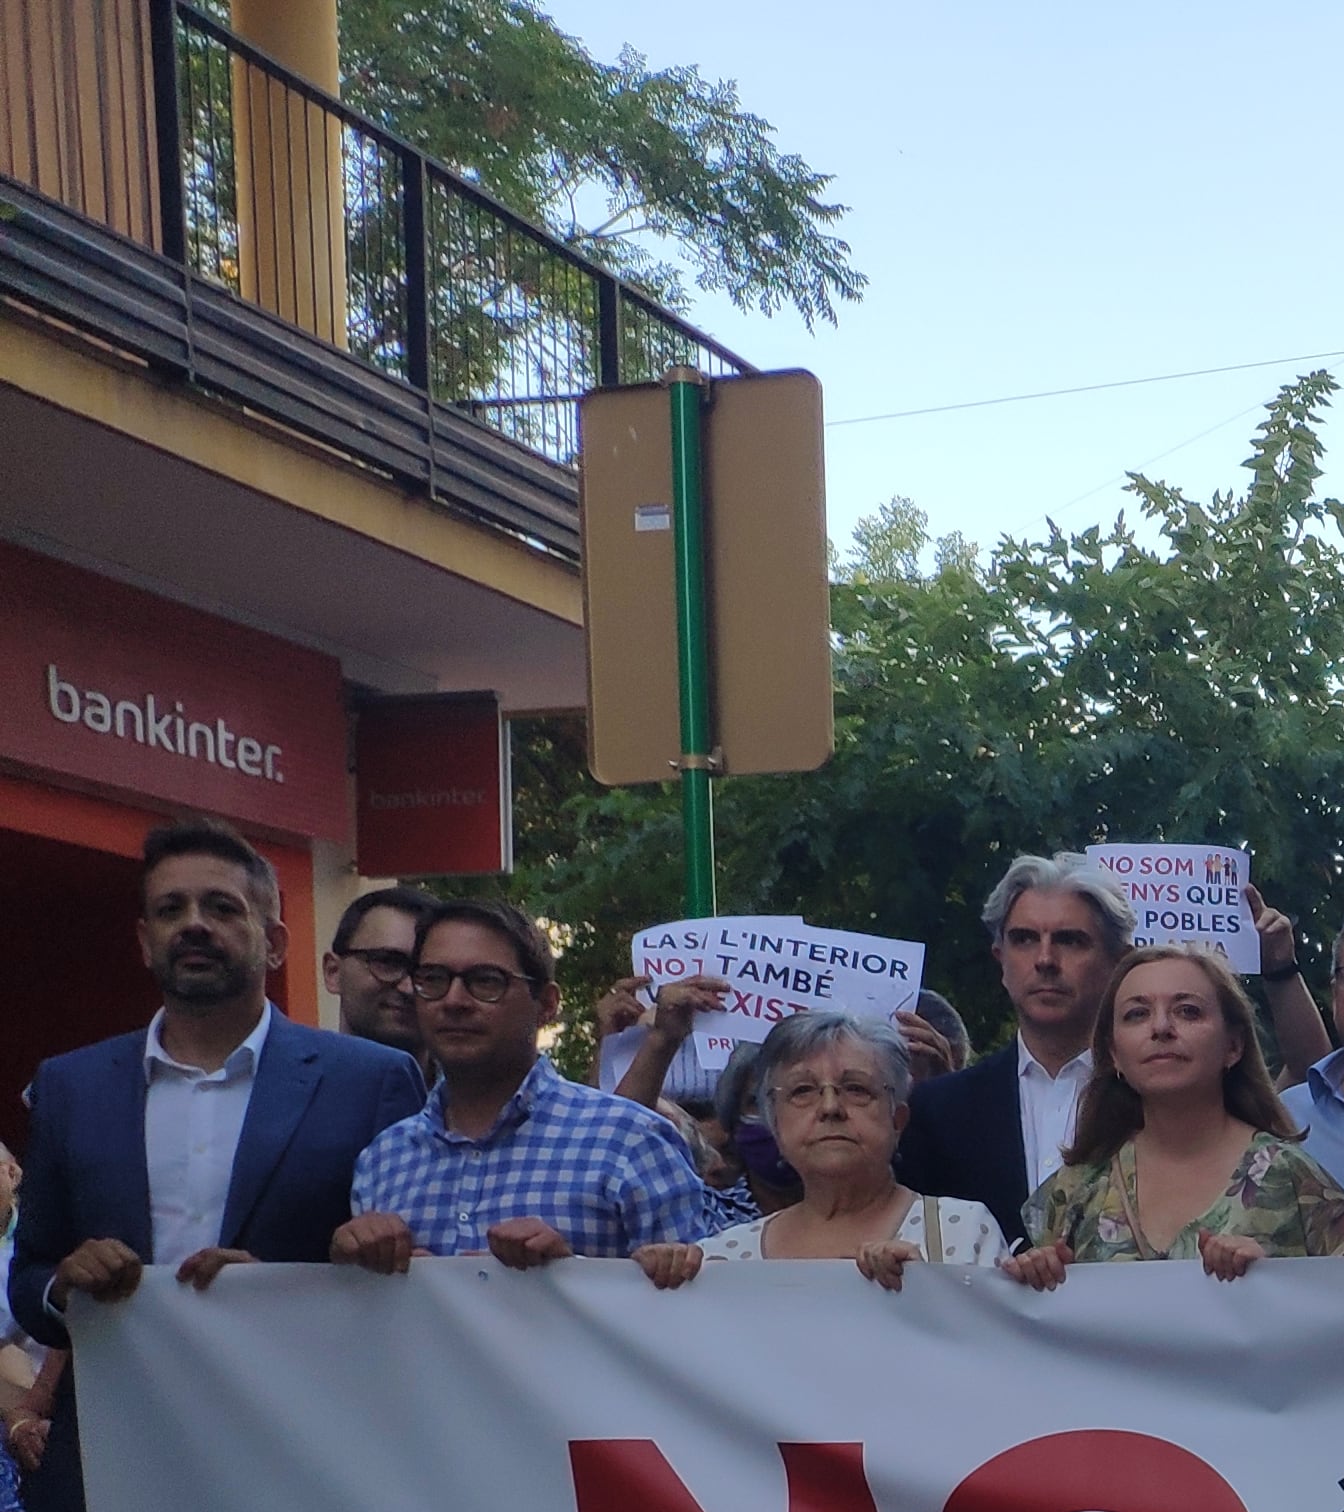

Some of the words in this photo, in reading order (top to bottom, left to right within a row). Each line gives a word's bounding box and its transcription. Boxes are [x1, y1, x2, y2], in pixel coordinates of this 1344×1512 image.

[47, 664, 285, 783] bankinter.
[1139, 857, 1194, 877] SOM
[1186, 885, 1239, 907] QUE
[1145, 910, 1241, 934] POBLES
[643, 933, 677, 949] LA
[720, 929, 910, 981] L'INTERIOR
[643, 957, 686, 977] NO
[716, 954, 835, 1000] TAMBÉ
